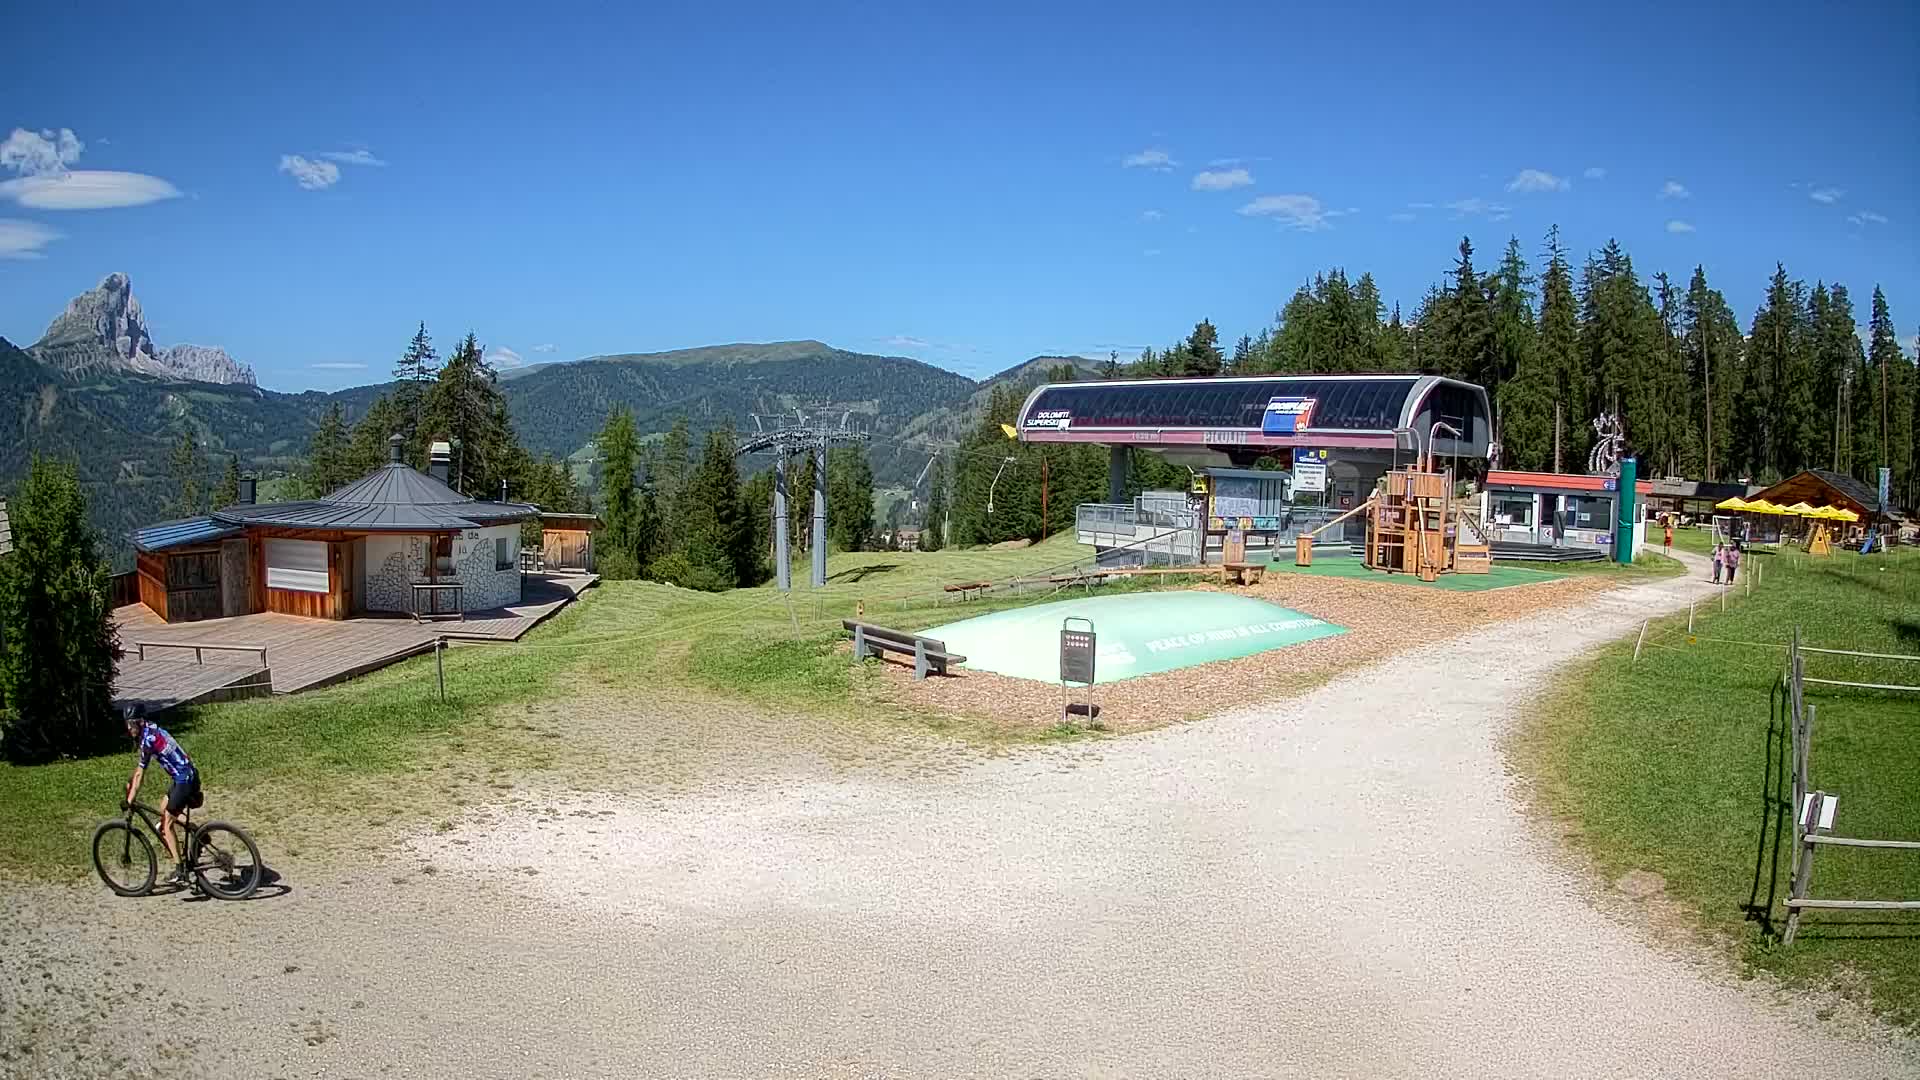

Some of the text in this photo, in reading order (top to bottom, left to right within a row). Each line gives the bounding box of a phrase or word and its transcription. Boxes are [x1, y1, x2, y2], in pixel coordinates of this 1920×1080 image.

[1037, 411, 1070, 419] DOLOMITI
[1026, 419, 1060, 427] SUPERSKI
[1203, 431, 1247, 444] PICULIN
[1145, 635, 1190, 653] PEACE
[1248, 623, 1271, 635] ALL
